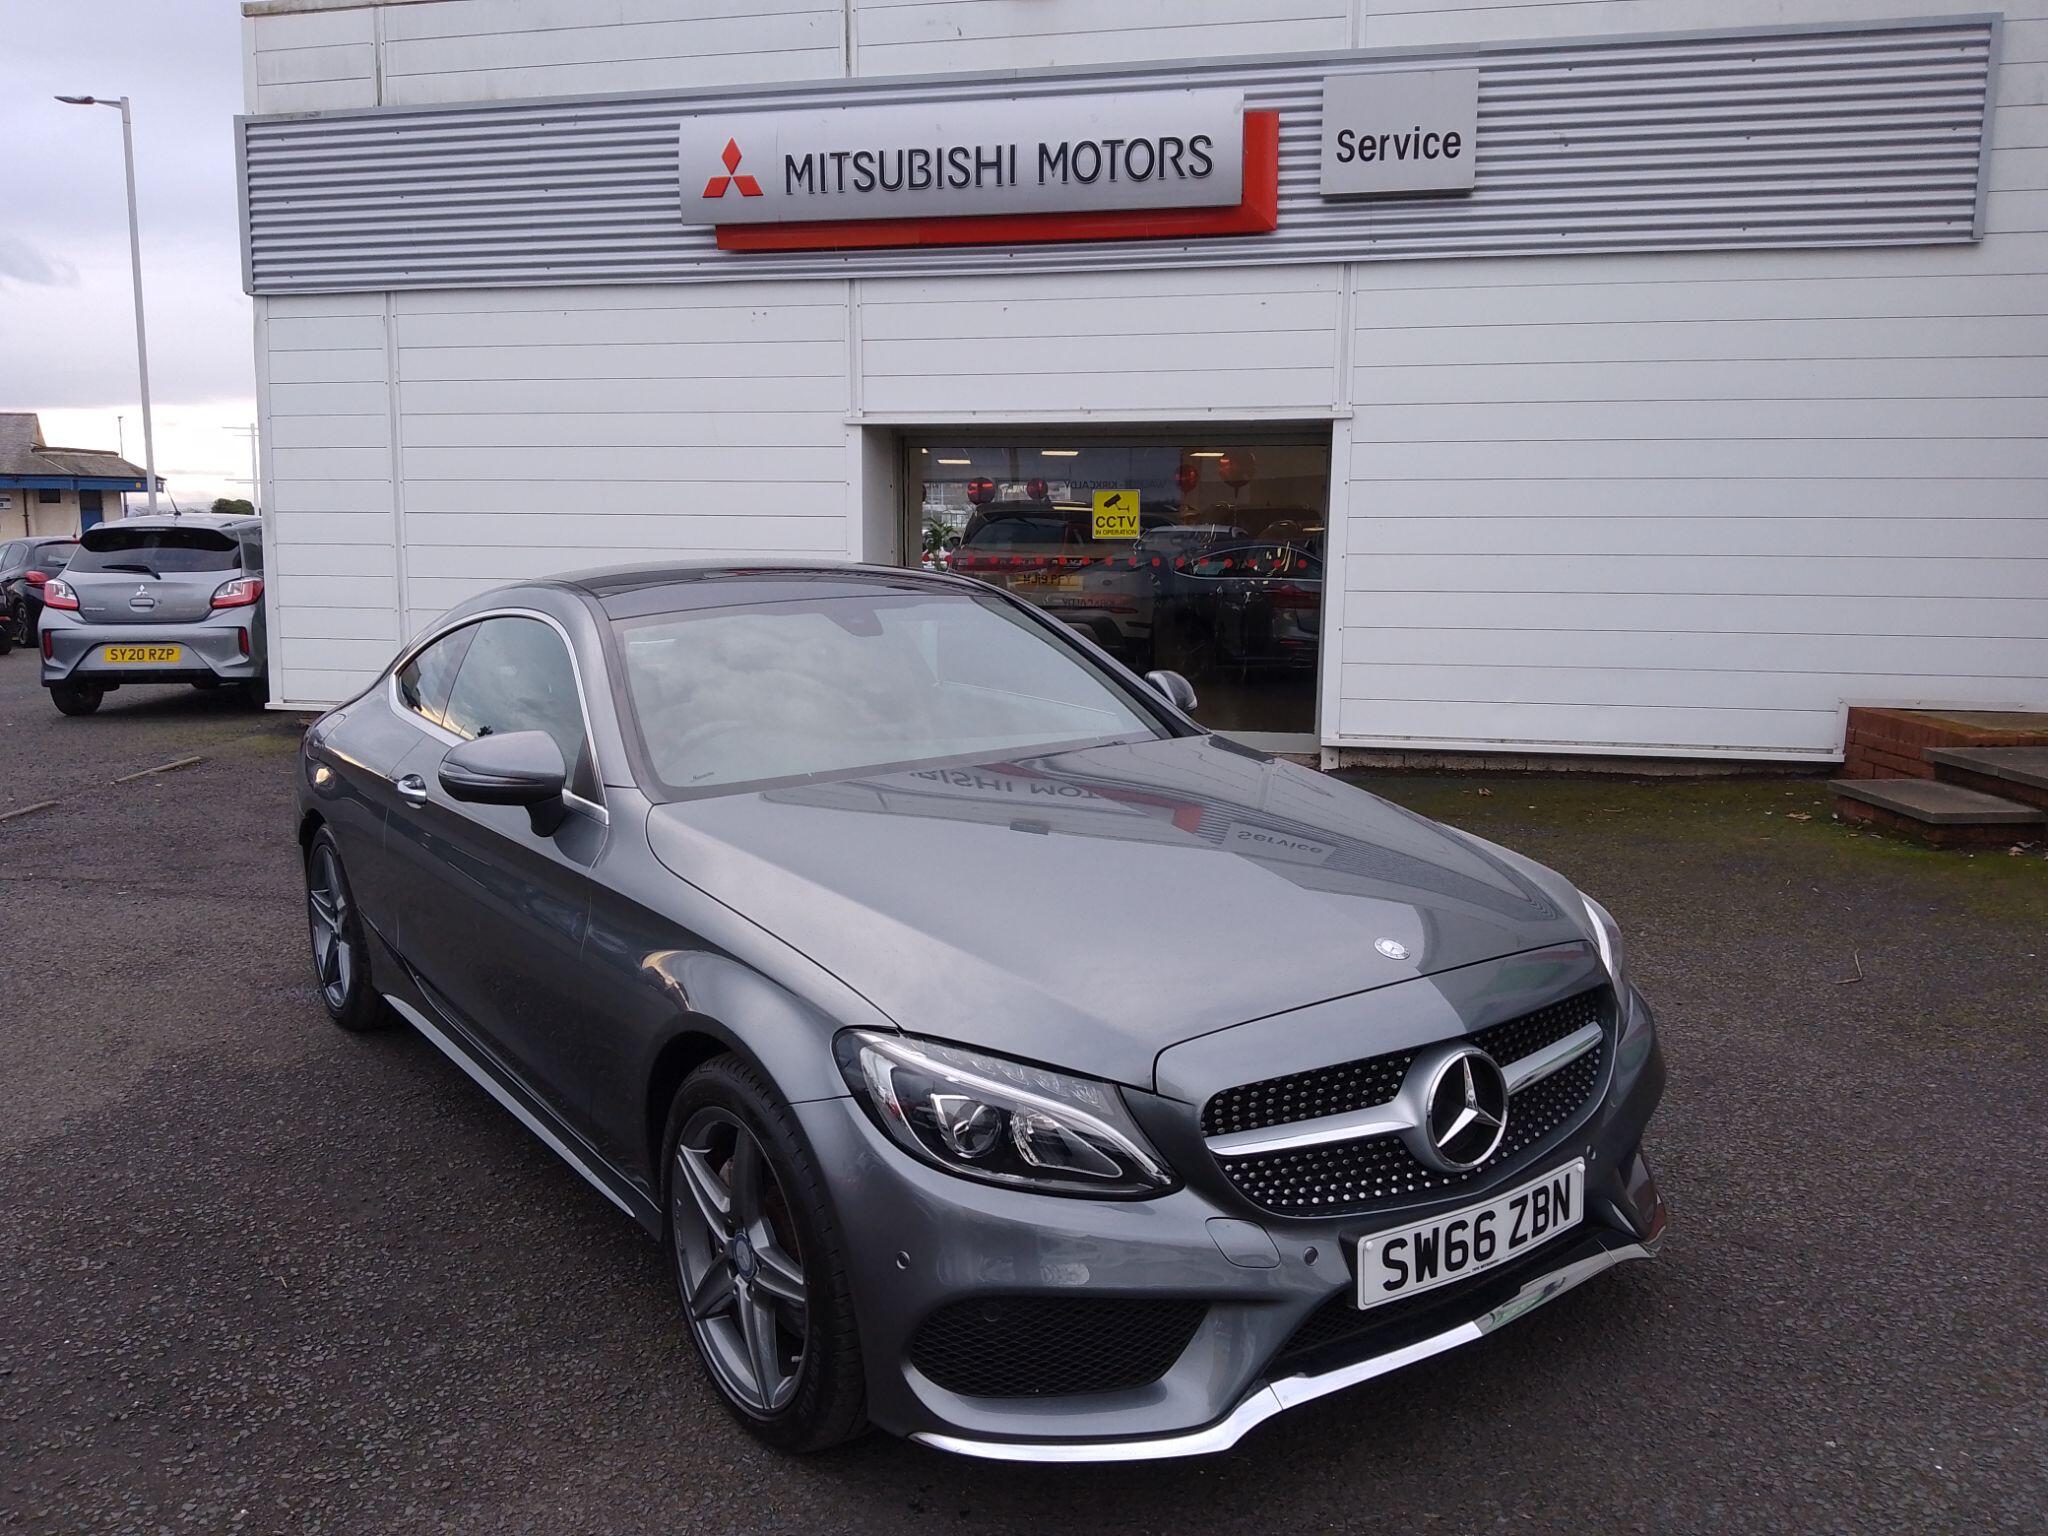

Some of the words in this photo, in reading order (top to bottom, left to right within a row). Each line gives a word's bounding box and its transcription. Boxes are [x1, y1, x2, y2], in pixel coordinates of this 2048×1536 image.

[784, 139, 1018, 195] MITSUBISHI
[1037, 133, 1215, 186] MOTORS
[1336, 124, 1462, 164] Service
[1095, 515, 1137, 528] CCTV
[110, 648, 145, 661] SY20
[148, 648, 175, 660] RZP
[1381, 1209, 1497, 1292] SW66
[1508, 1173, 1571, 1250] ZBN
